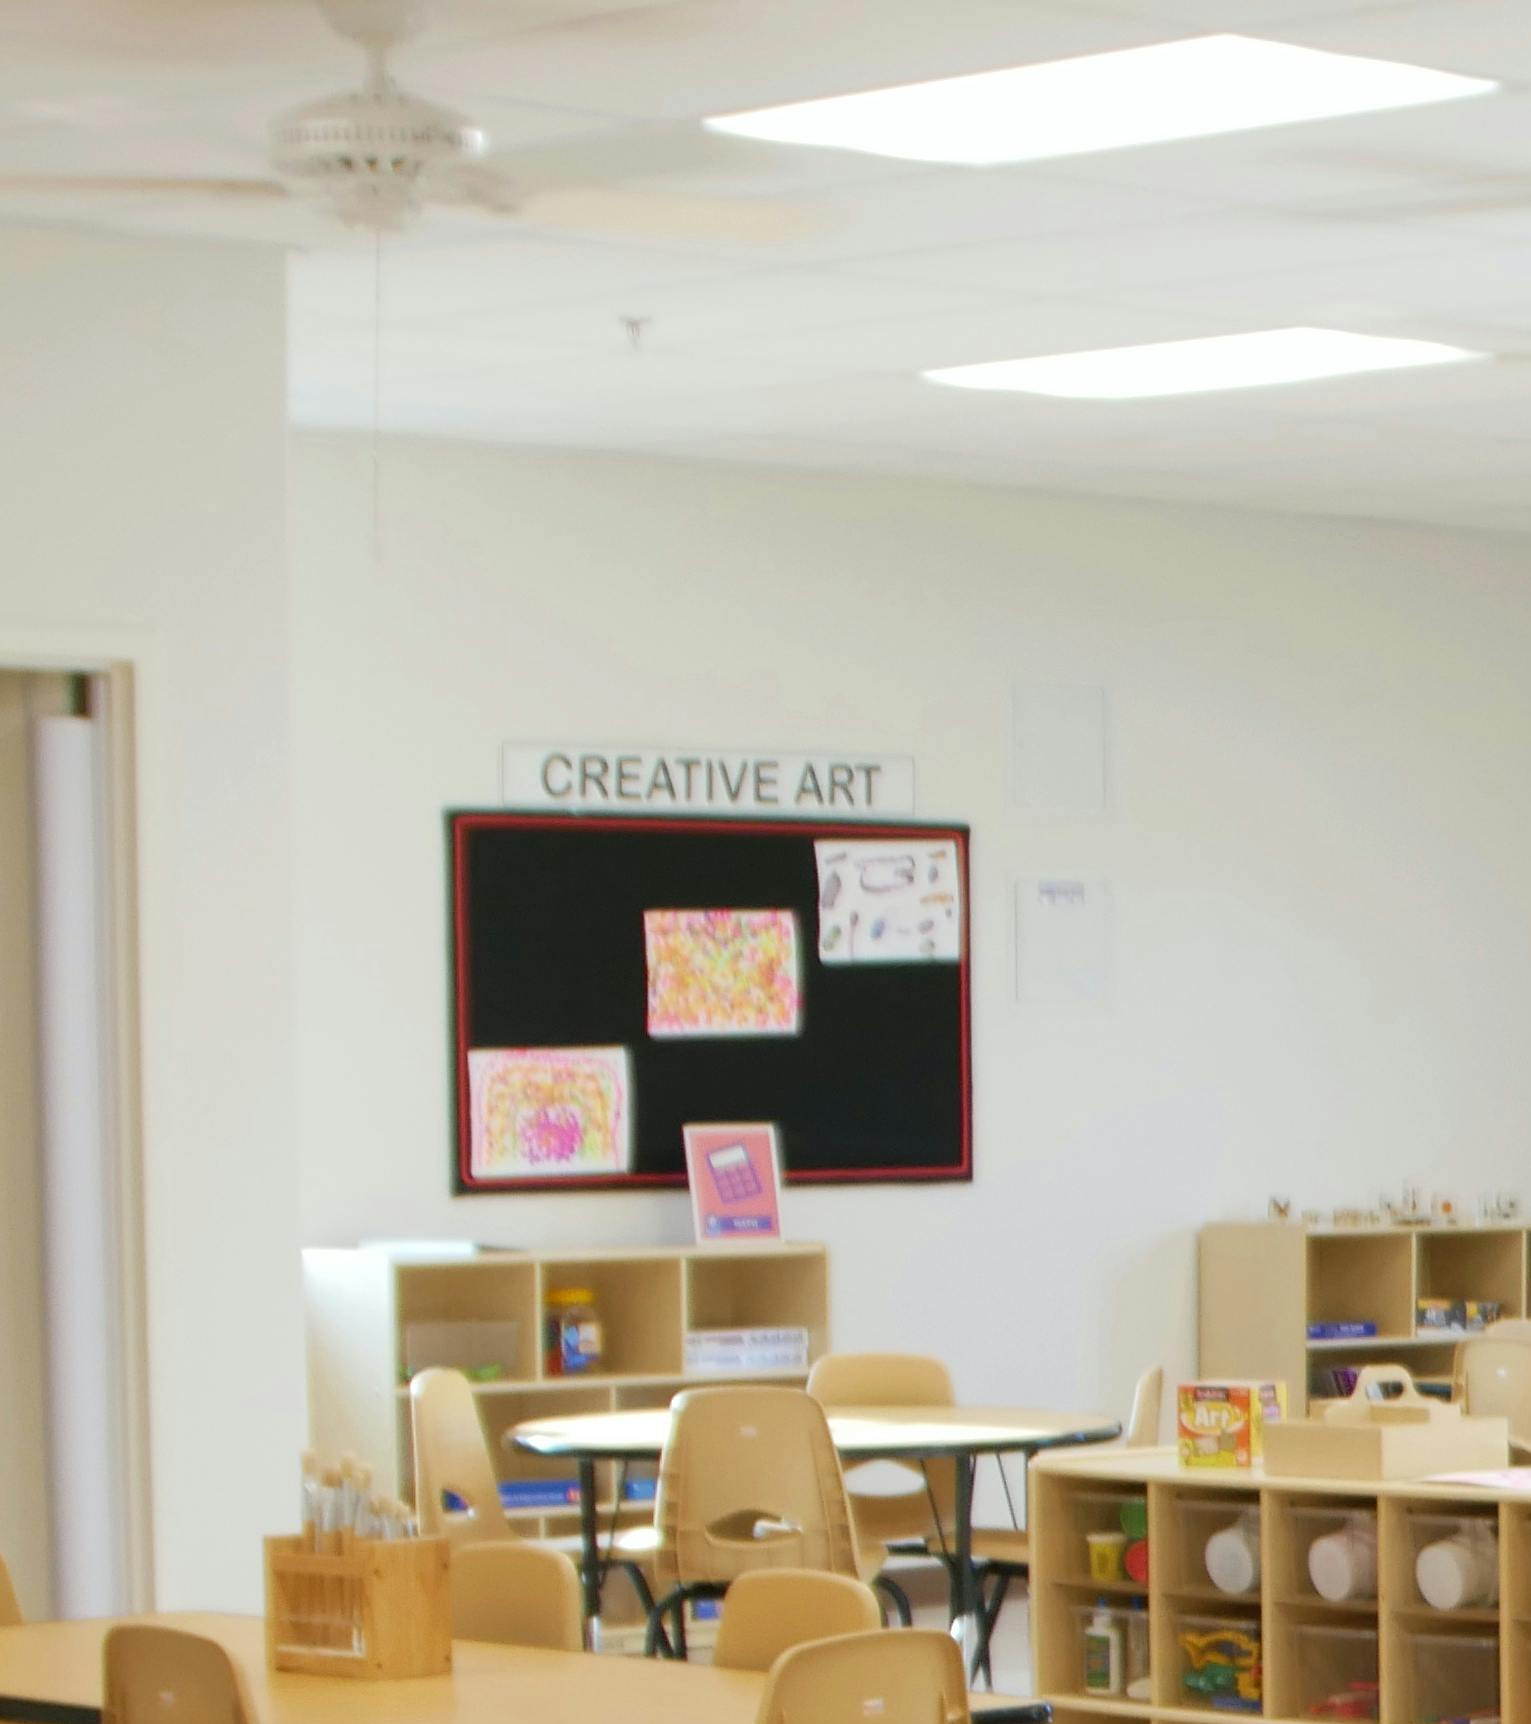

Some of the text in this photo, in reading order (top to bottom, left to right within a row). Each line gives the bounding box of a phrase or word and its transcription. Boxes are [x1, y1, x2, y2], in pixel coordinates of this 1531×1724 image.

[540, 752, 882, 806] CREATIVE ART
[1195, 1404, 1229, 1428] Art
